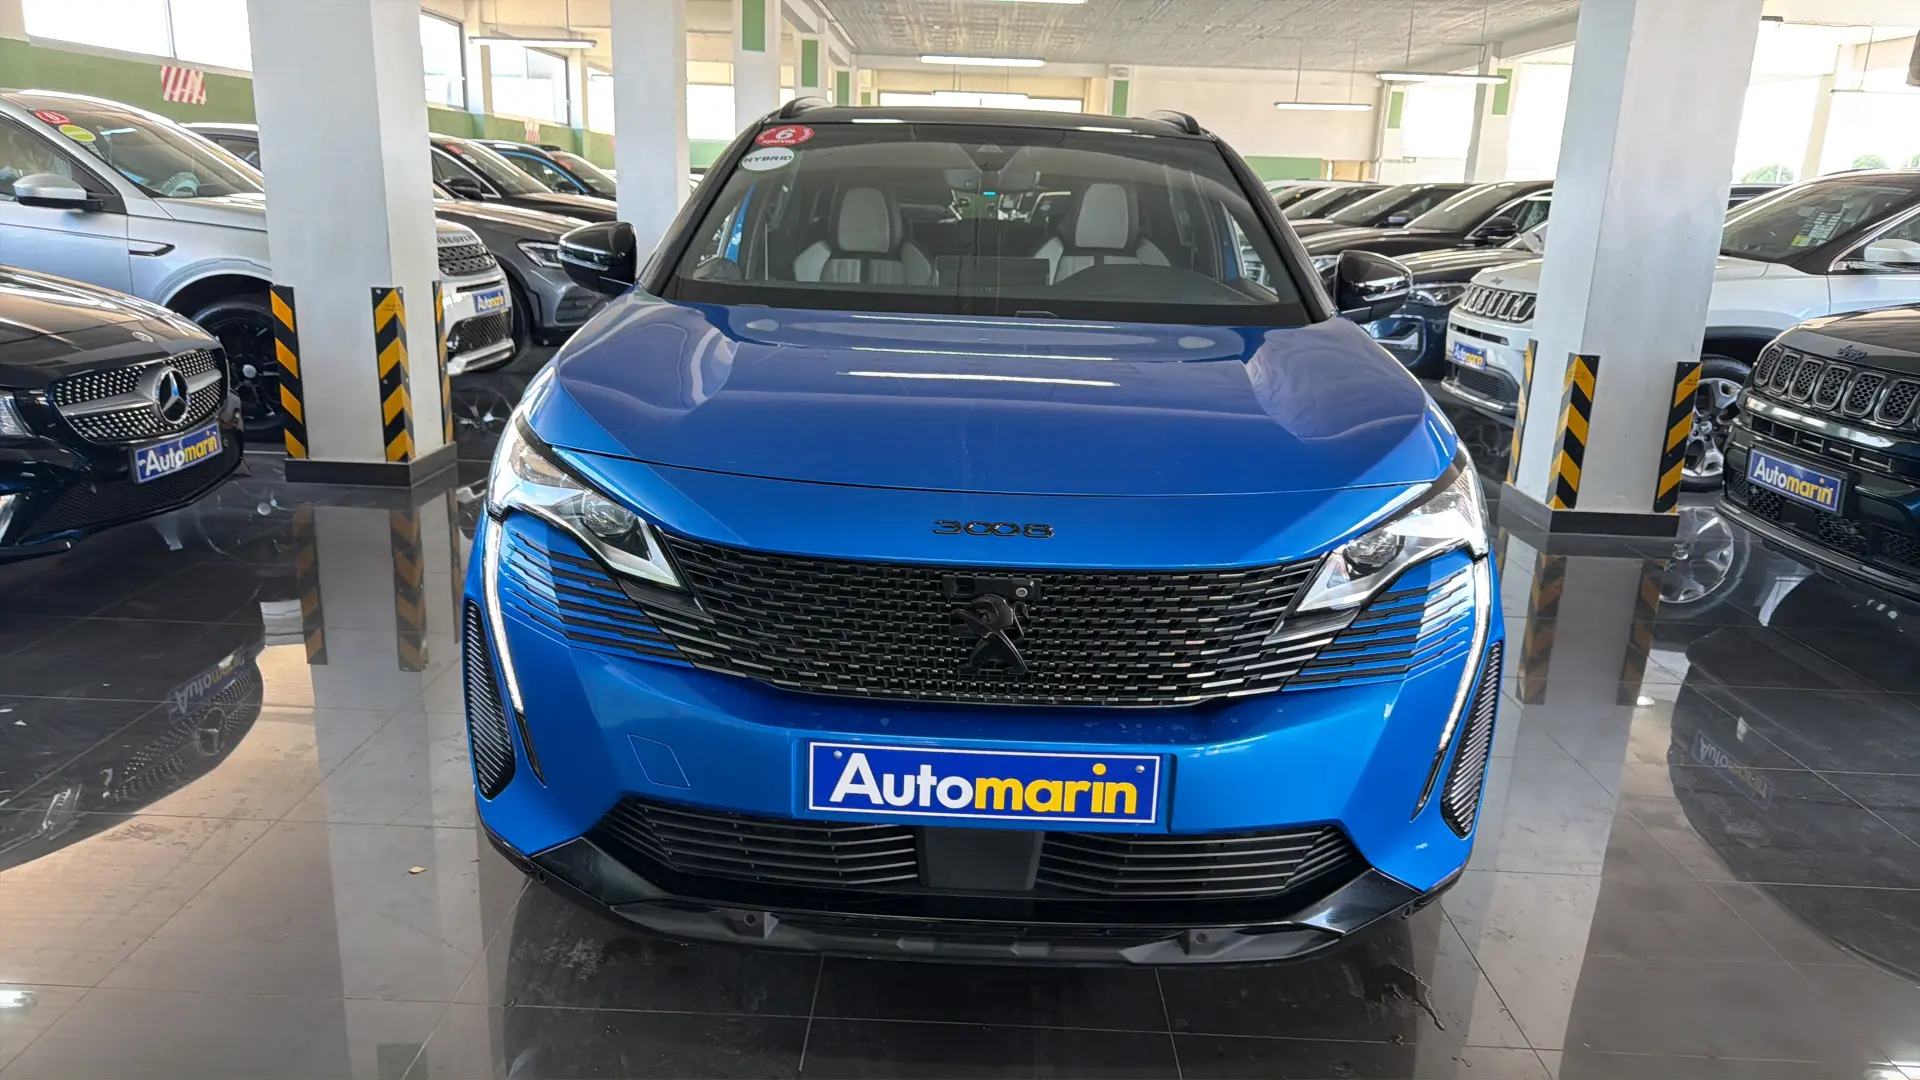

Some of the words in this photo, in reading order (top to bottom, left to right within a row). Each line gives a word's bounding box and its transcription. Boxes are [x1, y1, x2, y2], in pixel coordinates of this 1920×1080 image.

[775, 127, 797, 140] 6
[743, 154, 793, 163] HYBRID
[145, 430, 218, 476] Automarin
[1753, 456, 1833, 505] Automarin
[932, 519, 1055, 538] 3008
[829, 752, 1138, 814] Automarin
